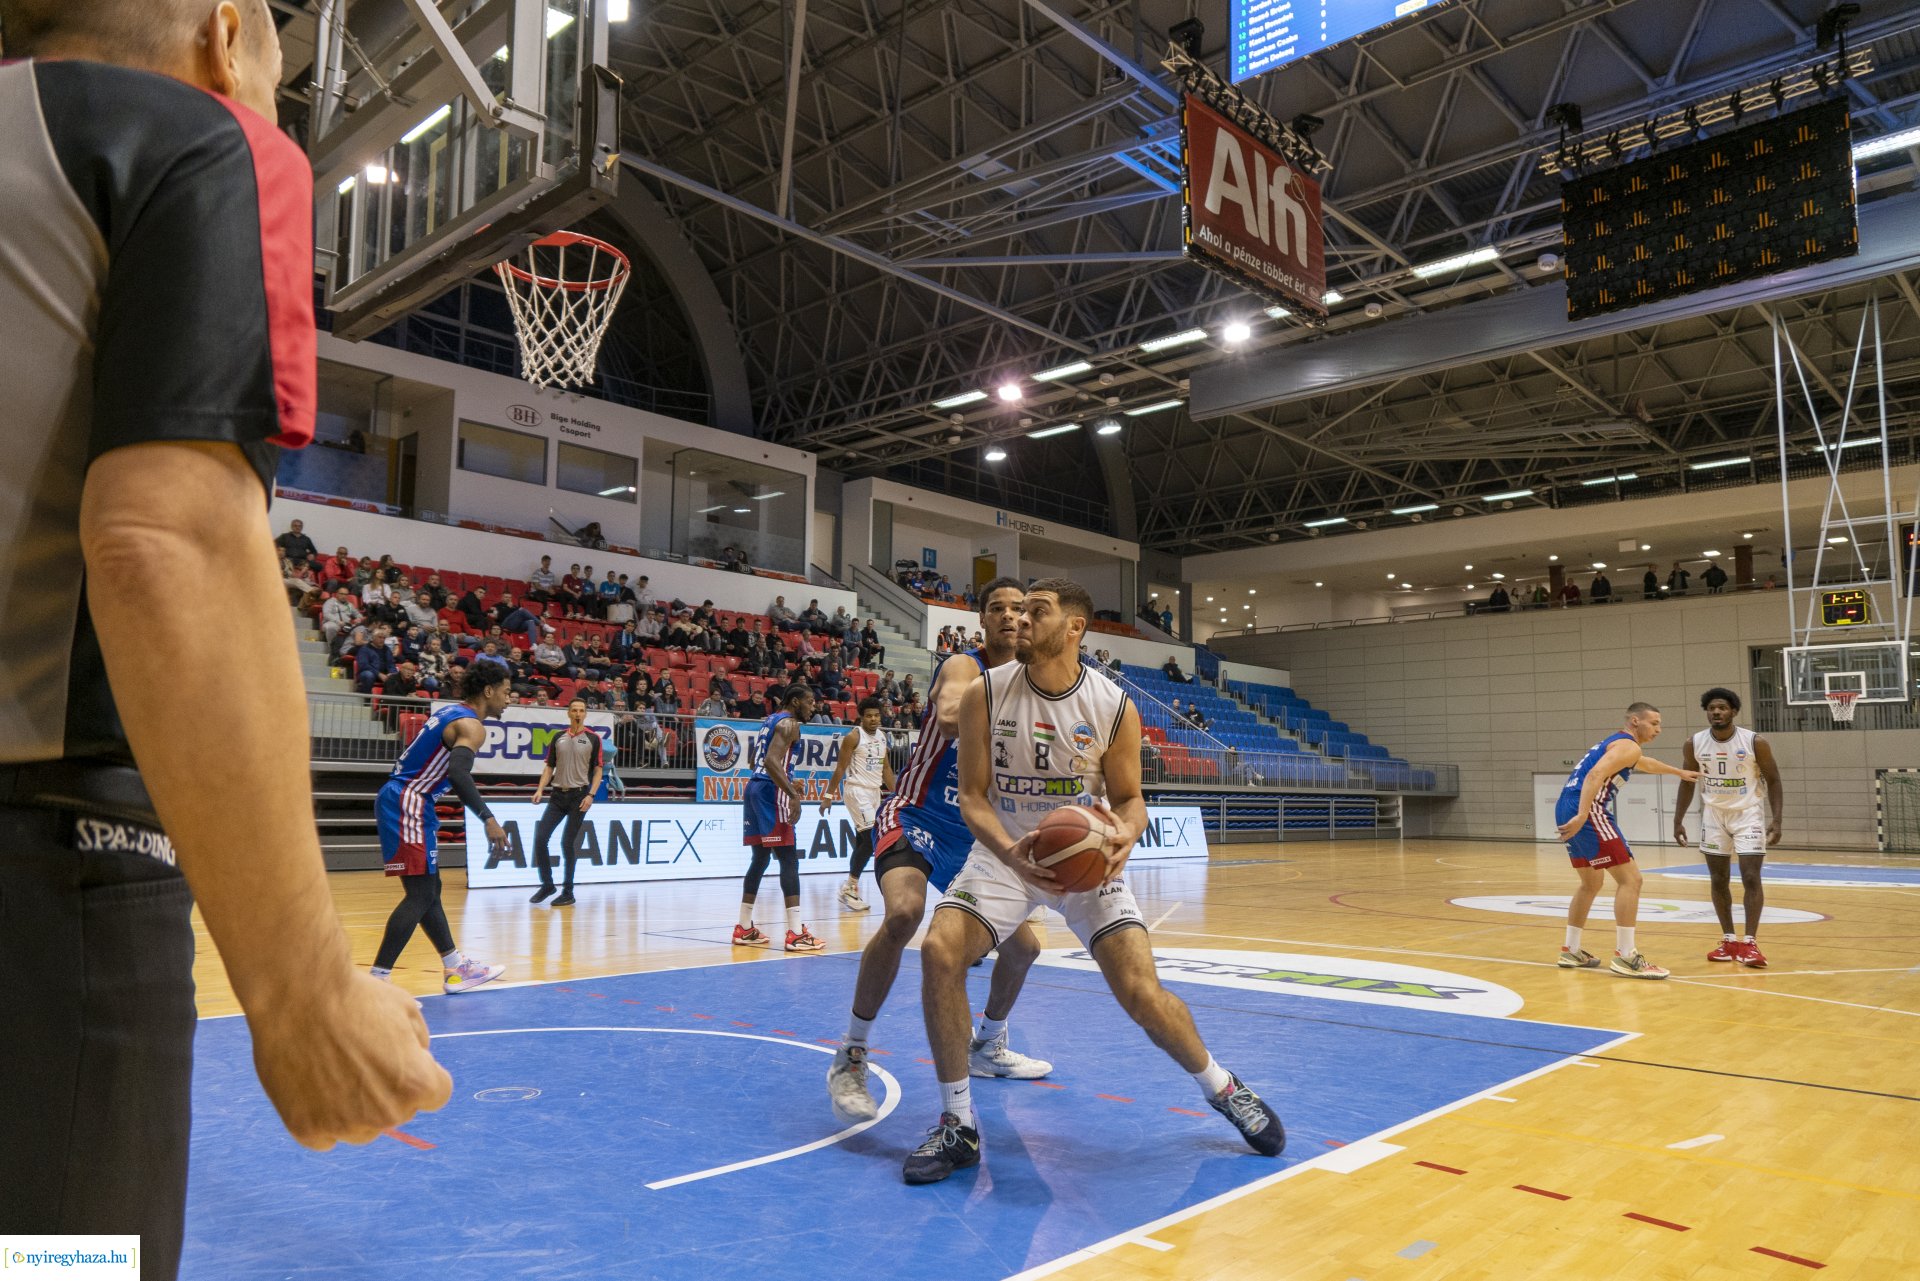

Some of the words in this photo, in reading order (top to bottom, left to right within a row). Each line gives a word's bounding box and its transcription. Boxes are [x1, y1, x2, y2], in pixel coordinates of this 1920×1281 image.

[1198, 224, 1223, 249] Ahol
[1224, 241, 1232, 253] a
[1232, 246, 1261, 271] pénze
[1262, 261, 1293, 289] többet
[1294, 278, 1307, 295] ér!
[512, 407, 536, 424] BH
[550, 412, 569, 423] Bige
[570, 417, 601, 432] Holding
[559, 425, 592, 438] Csoport
[997, 718, 1017, 728] JAKO
[1035, 741, 1050, 771] 8
[1098, 887, 1123, 898] ALAN
